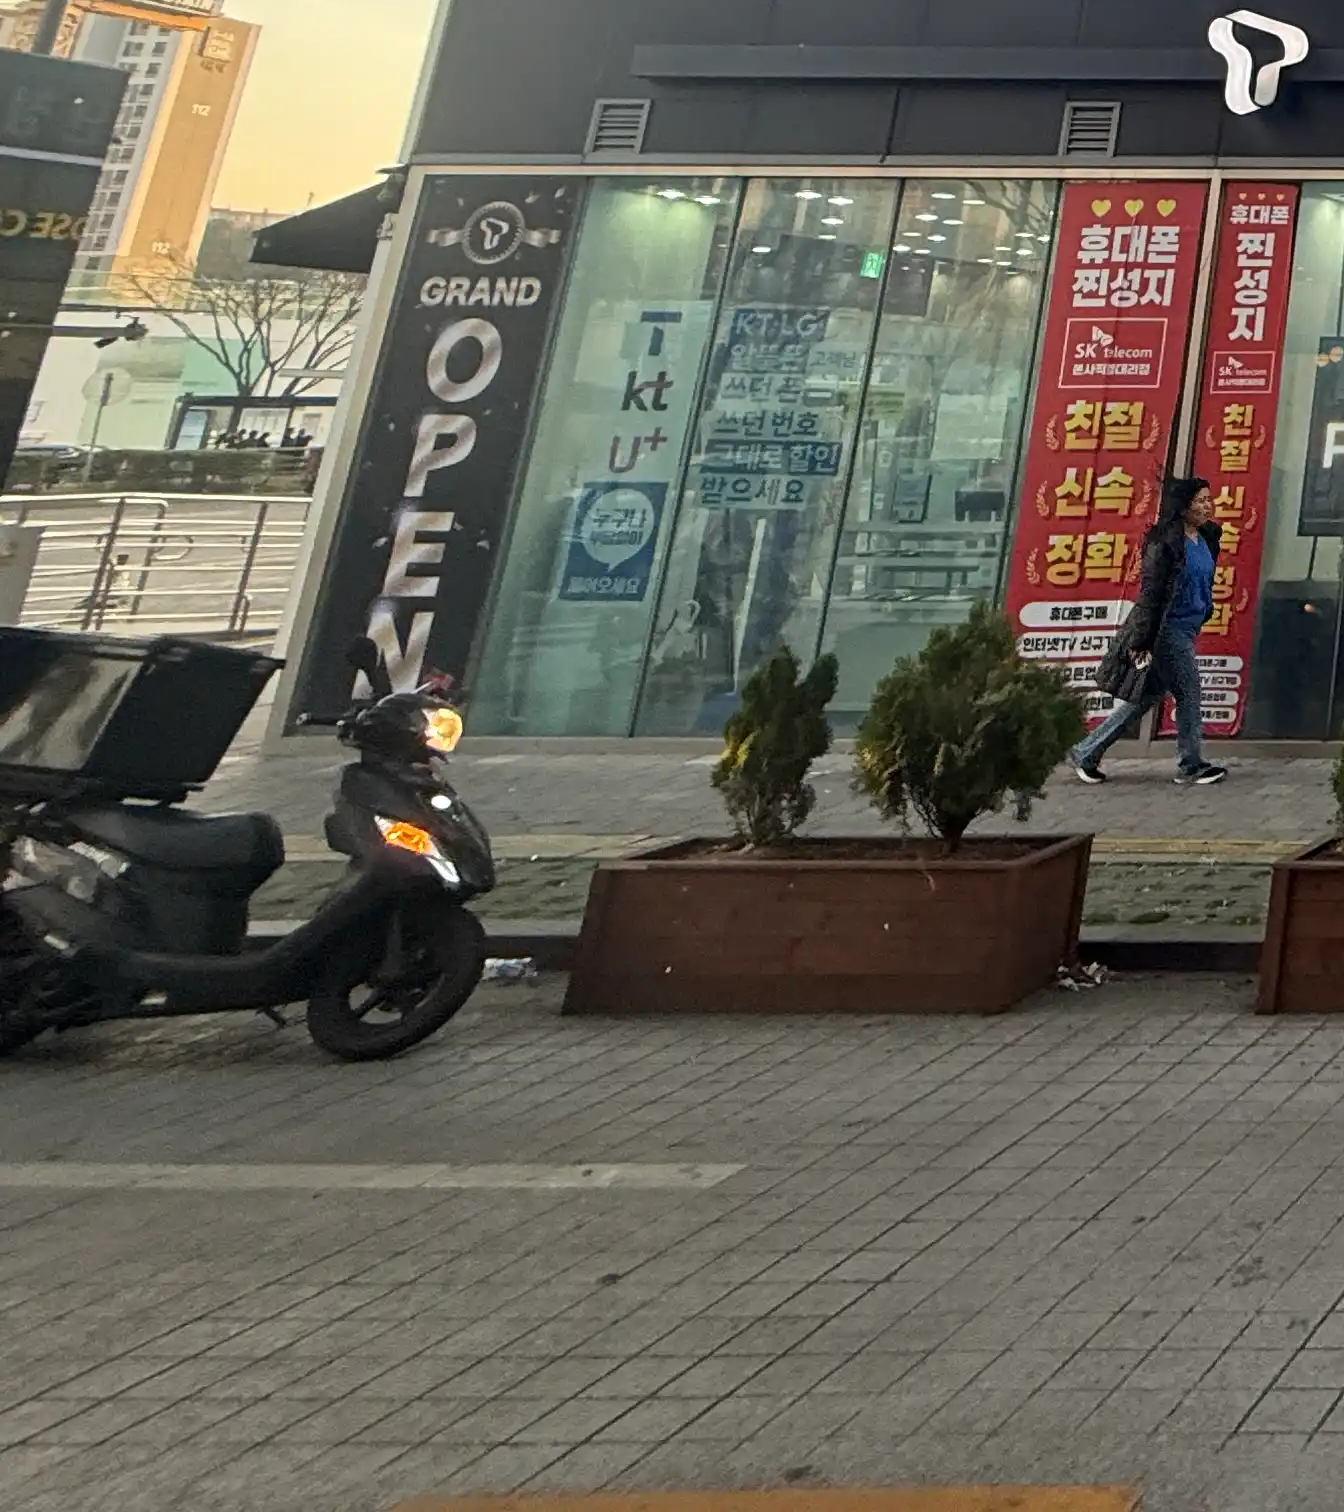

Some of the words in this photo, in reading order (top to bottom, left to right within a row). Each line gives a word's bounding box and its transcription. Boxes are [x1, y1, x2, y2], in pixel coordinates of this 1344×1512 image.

[1230, 204, 1290, 225] 휴대폰
[1077, 224, 1181, 265] 휴대폰
[420, 276, 542, 307] GRAND
[1072, 269, 1176, 308] 찐성지
[1227, 231, 1277, 342] 찐성지
[1074, 343, 1099, 359] SK
[1103, 345, 1154, 359] telecom
[620, 369, 674, 412] kt
[771, 410, 819, 438] 번호
[1064, 399, 1145, 450] 친절
[608, 426, 668, 474] U+
[702, 443, 783, 471] 그대로
[789, 444, 839, 473] 할인
[352, 317, 503, 699] OPEN
[701, 474, 805, 506] 받으세요
[1053, 466, 1135, 518] 신속
[1044, 532, 1129, 586] 정확
